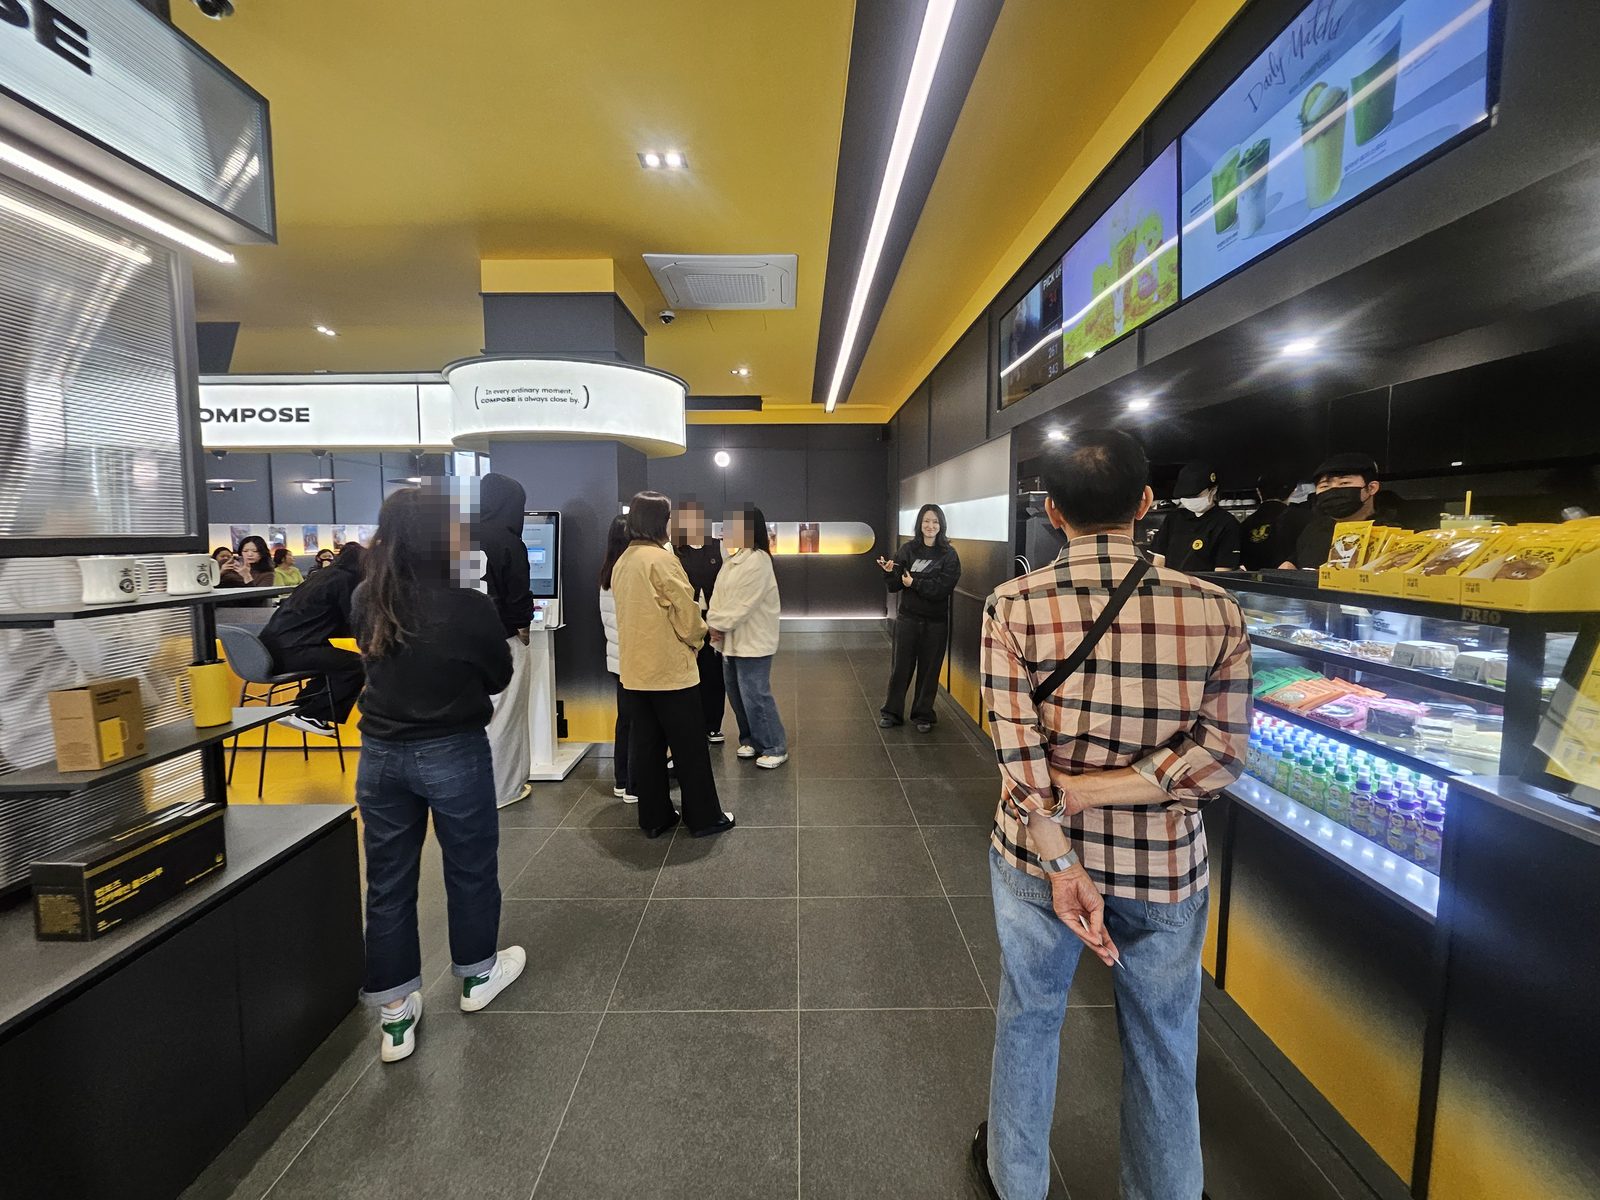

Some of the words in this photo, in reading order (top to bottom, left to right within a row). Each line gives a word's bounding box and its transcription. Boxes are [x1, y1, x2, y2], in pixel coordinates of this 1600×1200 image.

[1243, 51, 1286, 113] Daily
[493, 388, 509, 396] every
[541, 387, 574, 396] moment,
[524, 395, 548, 403] always
[549, 395, 568, 403] close
[569, 396, 580, 404] by.
[199, 407, 310, 423] OMPOSE
[1461, 607, 1501, 625] FRIO
